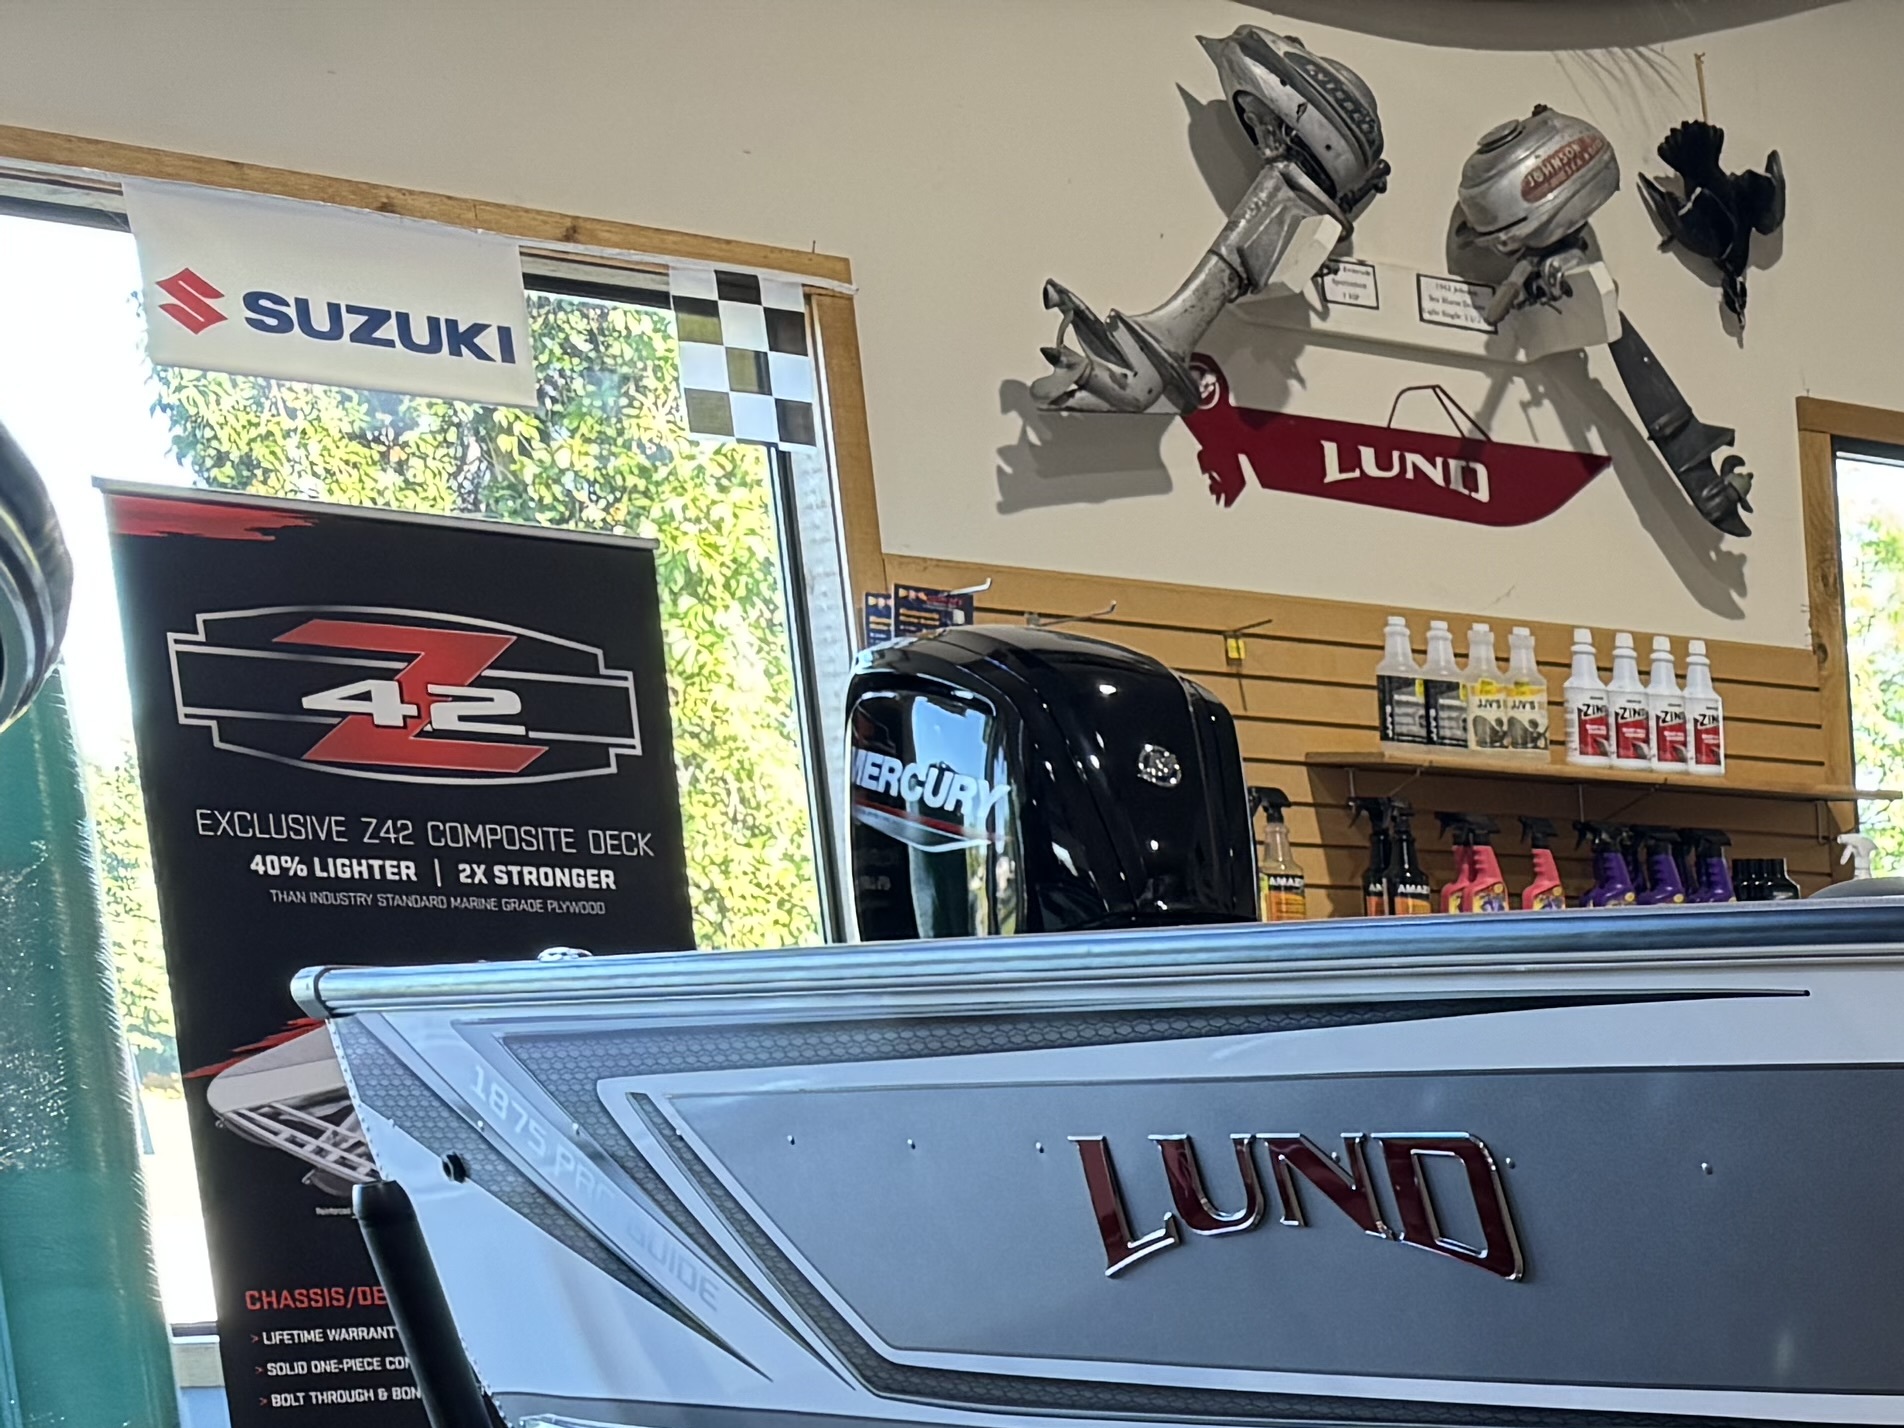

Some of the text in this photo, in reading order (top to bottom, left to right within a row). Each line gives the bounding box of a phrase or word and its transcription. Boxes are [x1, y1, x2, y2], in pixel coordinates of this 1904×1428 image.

[243, 289, 517, 365] SUZUKI
[1321, 440, 1489, 502] LUND
[196, 809, 655, 857] EXCLUSIVE Z42 COMPOSITE DECK
[250, 854, 617, 890] 40% LIGHTER 2X STRONGER
[270, 889, 606, 915] THAN INDUSTRY STANDARD MARINE GRADE PLYWOOD
[471, 1065, 548, 1156] 1875
[1067, 1131, 1525, 1281] LUND
[244, 1286, 388, 1311] CHASSIS/DE
[262, 1329, 325, 1345] LIFETIME
[266, 1357, 382, 1376] SOLID ONE-PIECE
[271, 1385, 422, 1407] BOLT THROUGH & BON
